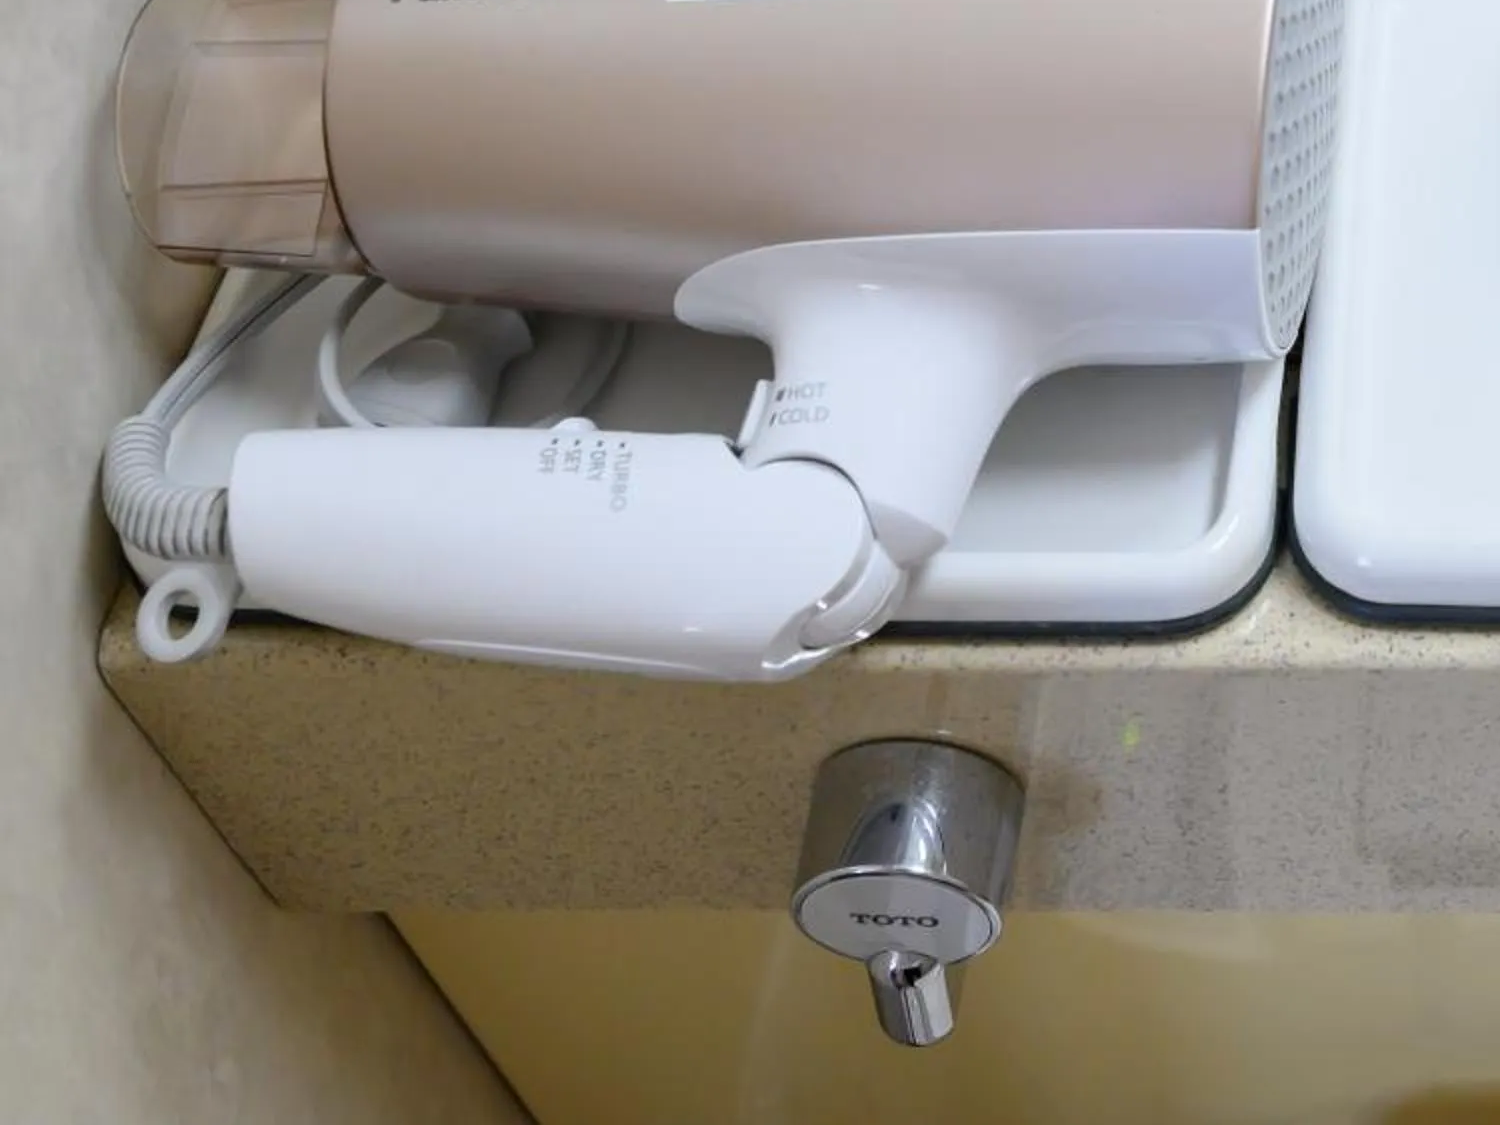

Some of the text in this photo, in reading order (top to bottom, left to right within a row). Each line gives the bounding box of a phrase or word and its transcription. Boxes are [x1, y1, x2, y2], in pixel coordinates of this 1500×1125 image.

[788, 382, 825, 400] HOT
[778, 406, 829, 426] COLD
[538, 447, 559, 474] OFF
[563, 448, 583, 473] SET
[586, 449, 608, 481] DRY
[609, 450, 633, 513] TURBO
[849, 912, 939, 928] TOTO
